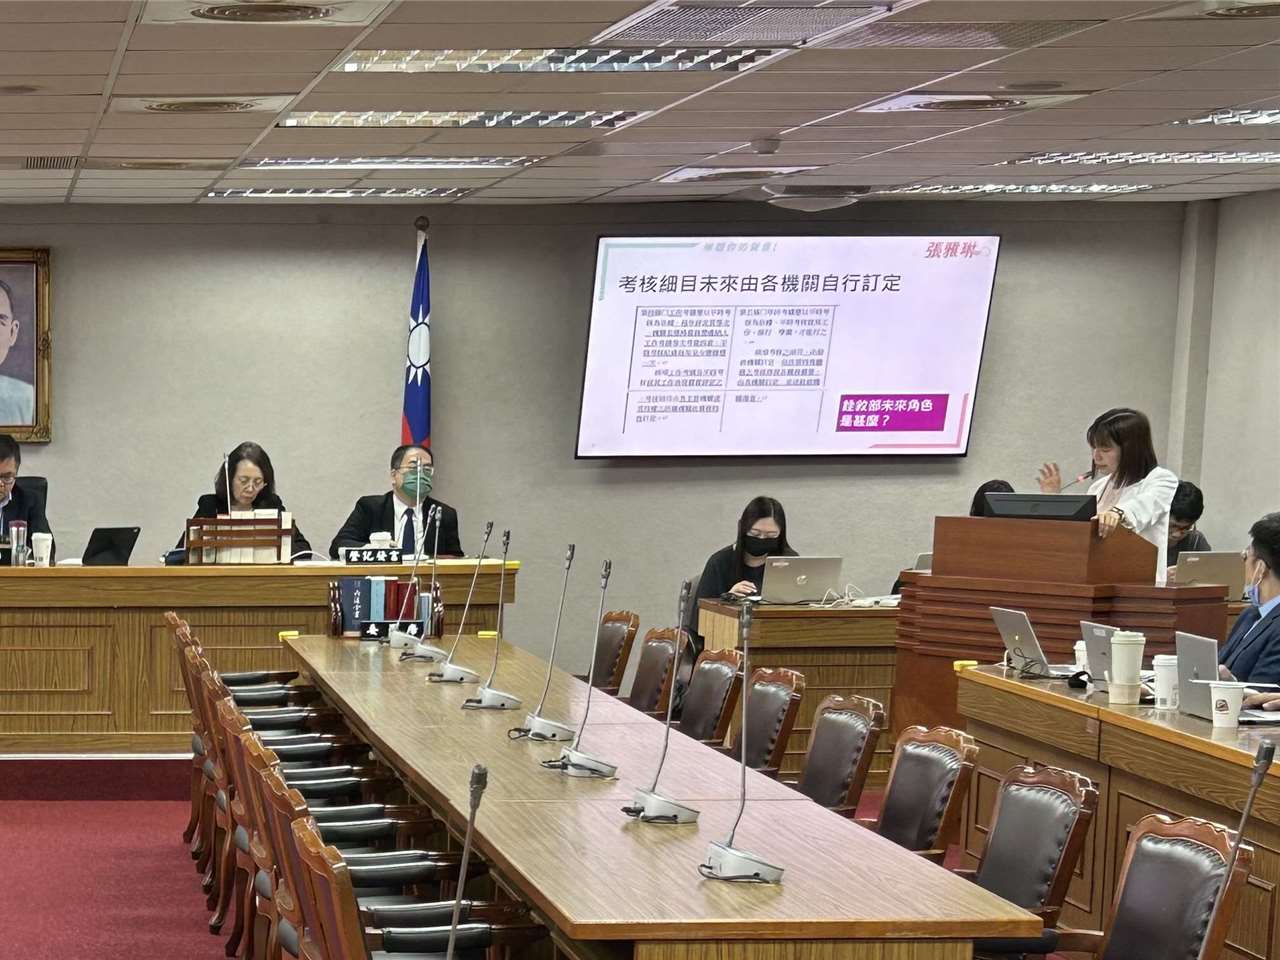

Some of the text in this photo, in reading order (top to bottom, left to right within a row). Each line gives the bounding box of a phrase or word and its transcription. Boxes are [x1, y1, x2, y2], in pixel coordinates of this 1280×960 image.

[924, 241, 977, 258] 張雅琳
[618, 273, 902, 294] 考核細目未來由各機關自行訂定
[349, 550, 400, 562] 登記發言
[366, 623, 419, 636] 委席
